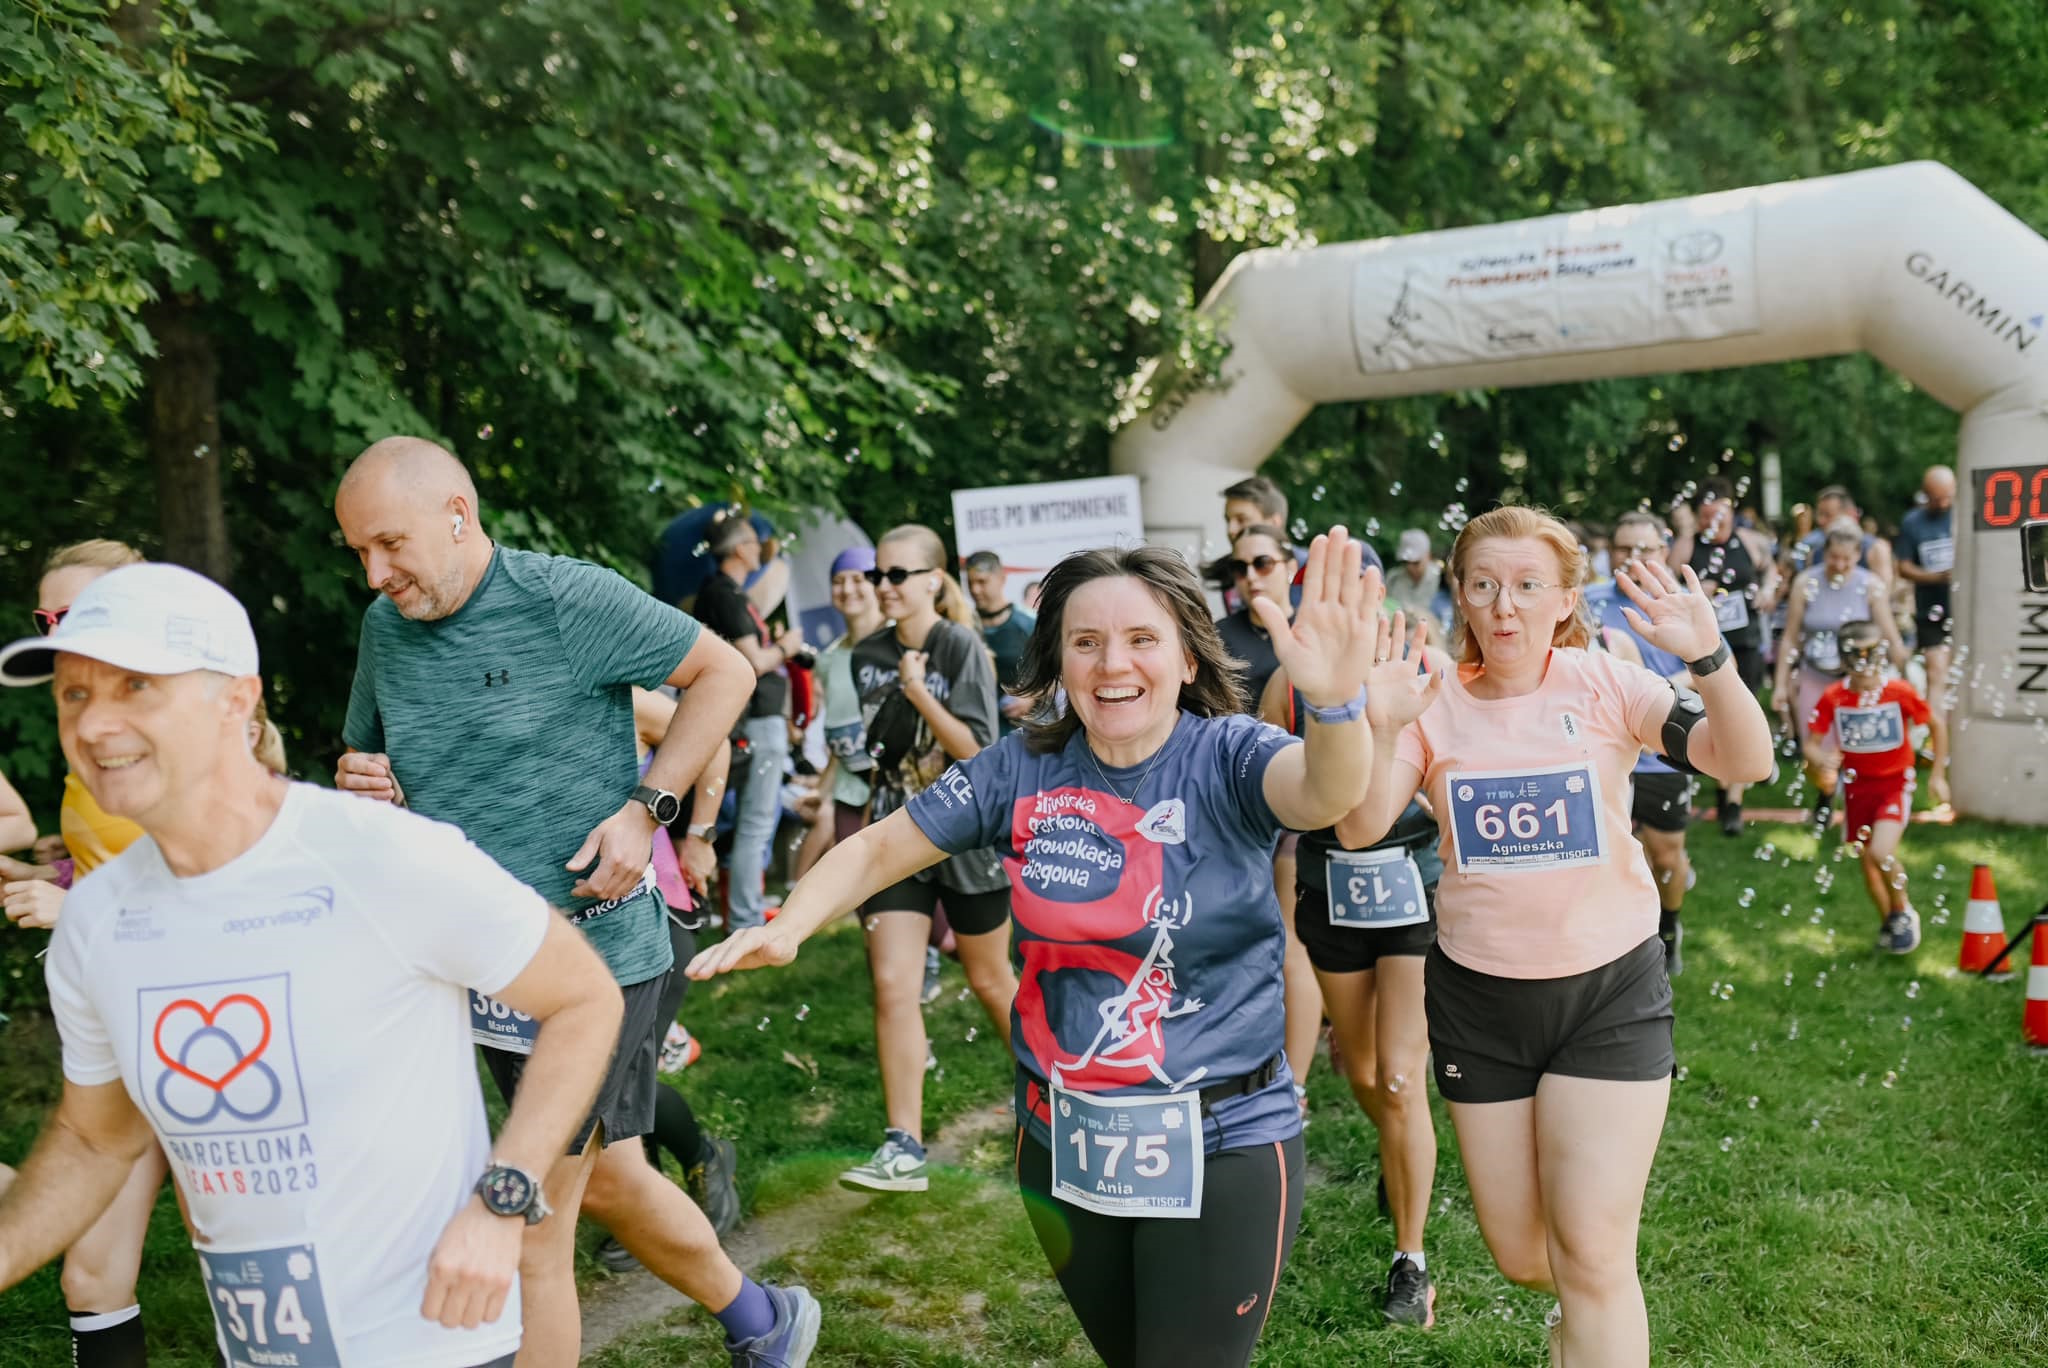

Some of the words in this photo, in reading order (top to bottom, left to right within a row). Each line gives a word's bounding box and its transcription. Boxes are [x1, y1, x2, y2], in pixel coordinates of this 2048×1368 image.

[1905, 252, 2036, 351] GARMIN
[1475, 798, 1569, 840] 661
[1491, 839, 1564, 856] Agnieszka
[1555, 848, 1593, 861] ETISOFT
[1348, 876, 1392, 904] 13
[585, 898, 618, 919] PKO
[488, 1019, 519, 1034] Marek
[168, 1132, 313, 1167] BARCELONA
[1070, 1127, 1171, 1178] 175
[1096, 1179, 1134, 1195] Ania
[1143, 1196, 1186, 1208] ETISOFT
[216, 1285, 313, 1345] 374
